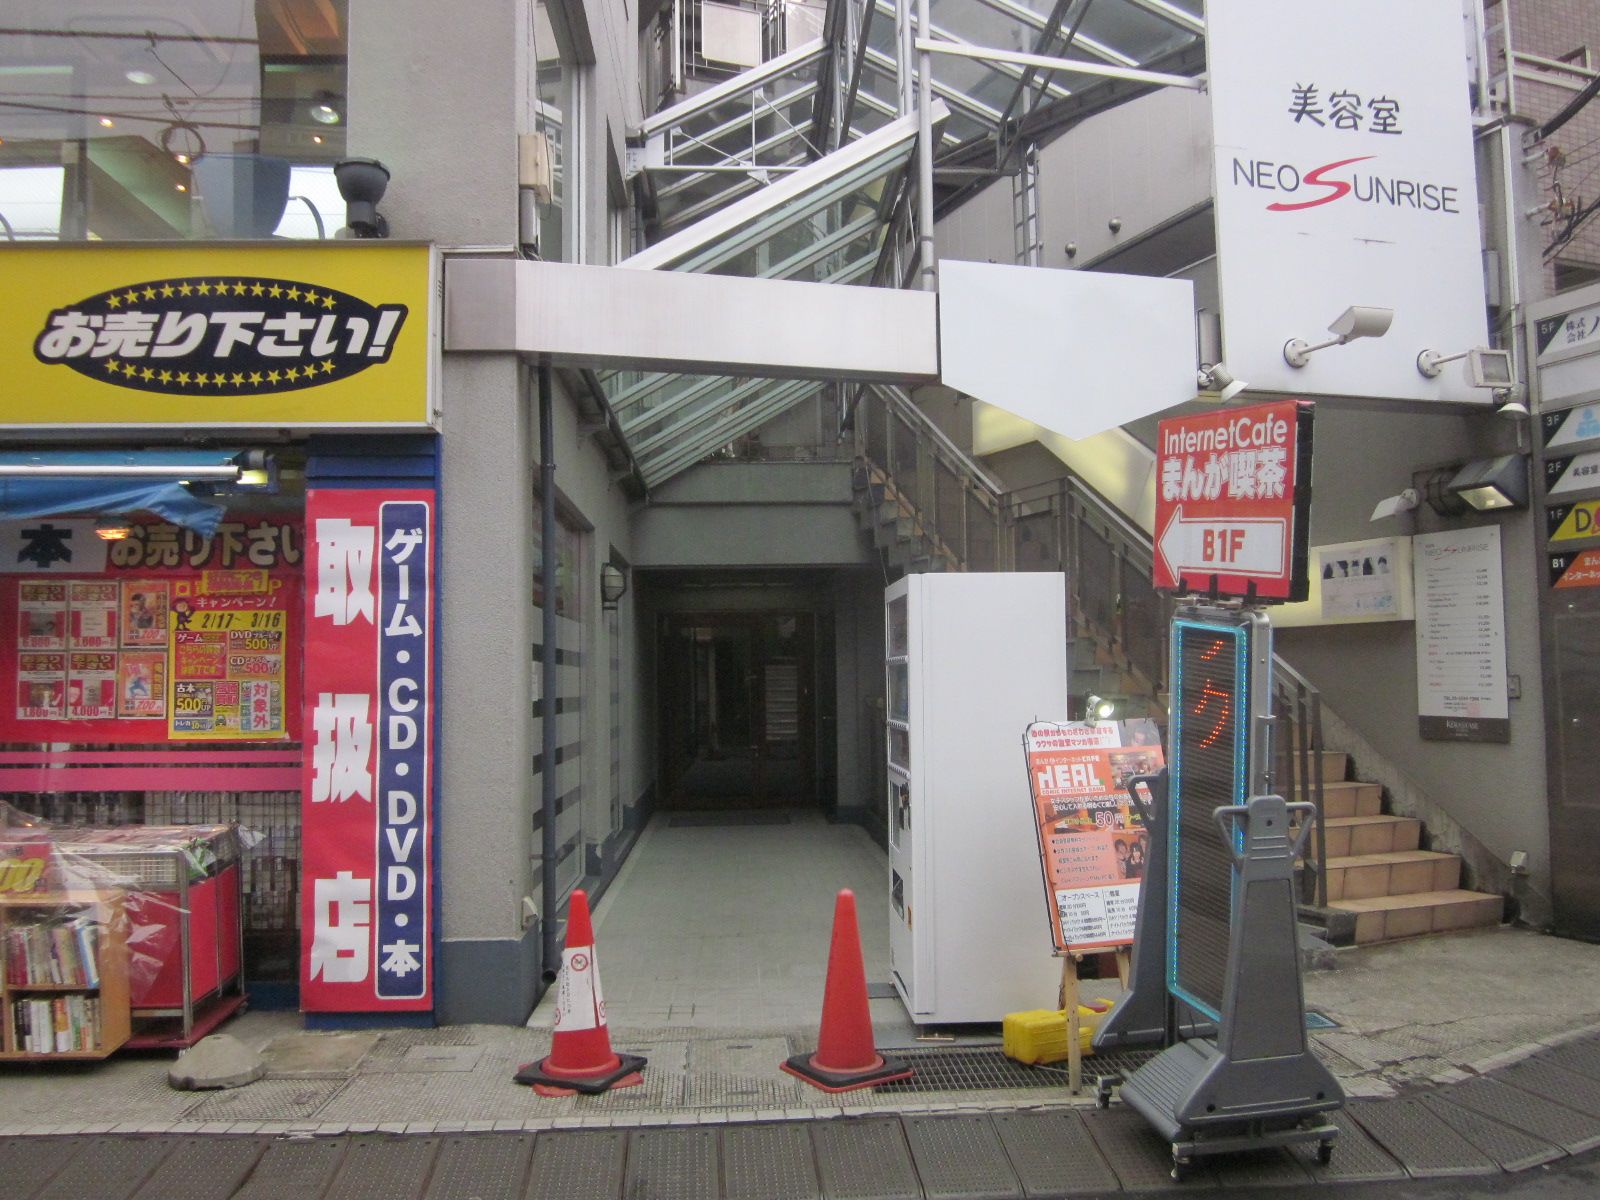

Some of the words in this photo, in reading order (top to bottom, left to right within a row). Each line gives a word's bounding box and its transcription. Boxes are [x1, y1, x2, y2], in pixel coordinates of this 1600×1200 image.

[1288, 82, 1403, 135] 美容室
[1233, 157, 1300, 192] NEO
[38, 309, 404, 359] お売り下さい!
[1546, 414, 1560, 426] 3F
[1162, 447, 1287, 501] まんが喫茶
[1547, 461, 1561, 473] 2F
[17, 523, 73, 568] 本
[1202, 529, 1246, 562] B1F
[1552, 559, 1564, 568] B1
[230, 630, 252, 639] DVD
[251, 612, 281, 628] 3/16
[178, 633, 203, 643] ゲーム
[230, 656, 245, 665] CD
[253, 681, 269, 729] 対象外
[309, 518, 375, 983] 取扱店
[381, 527, 424, 977] ゲーム・CD・DVD・本
[1037, 763, 1101, 789] HEAL
